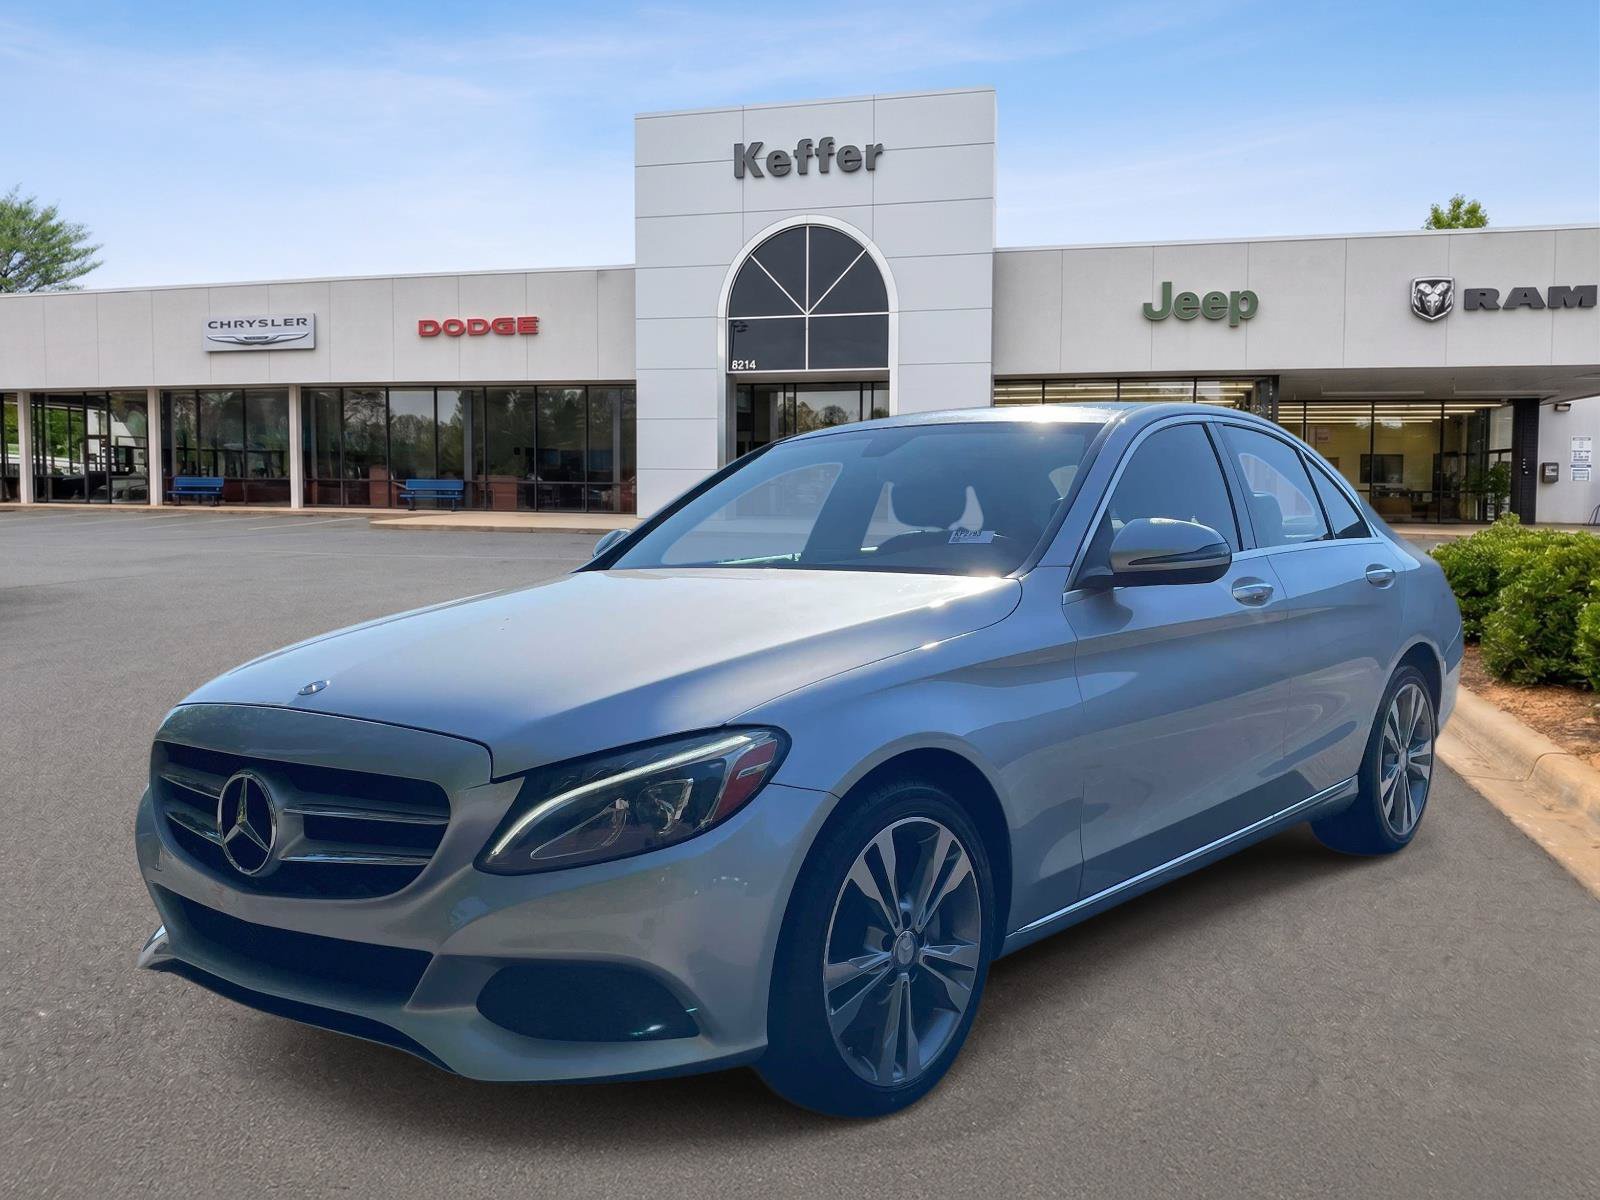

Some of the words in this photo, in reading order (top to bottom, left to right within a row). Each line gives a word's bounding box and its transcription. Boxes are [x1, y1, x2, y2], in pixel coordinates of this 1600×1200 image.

[734, 136, 884, 179] Keffer
[1143, 281, 1259, 327] Jeep
[1464, 285, 1598, 310] RAM
[207, 317, 308, 330] CHRYSLER
[418, 316, 539, 337] DODGE
[731, 359, 757, 370] 8214
